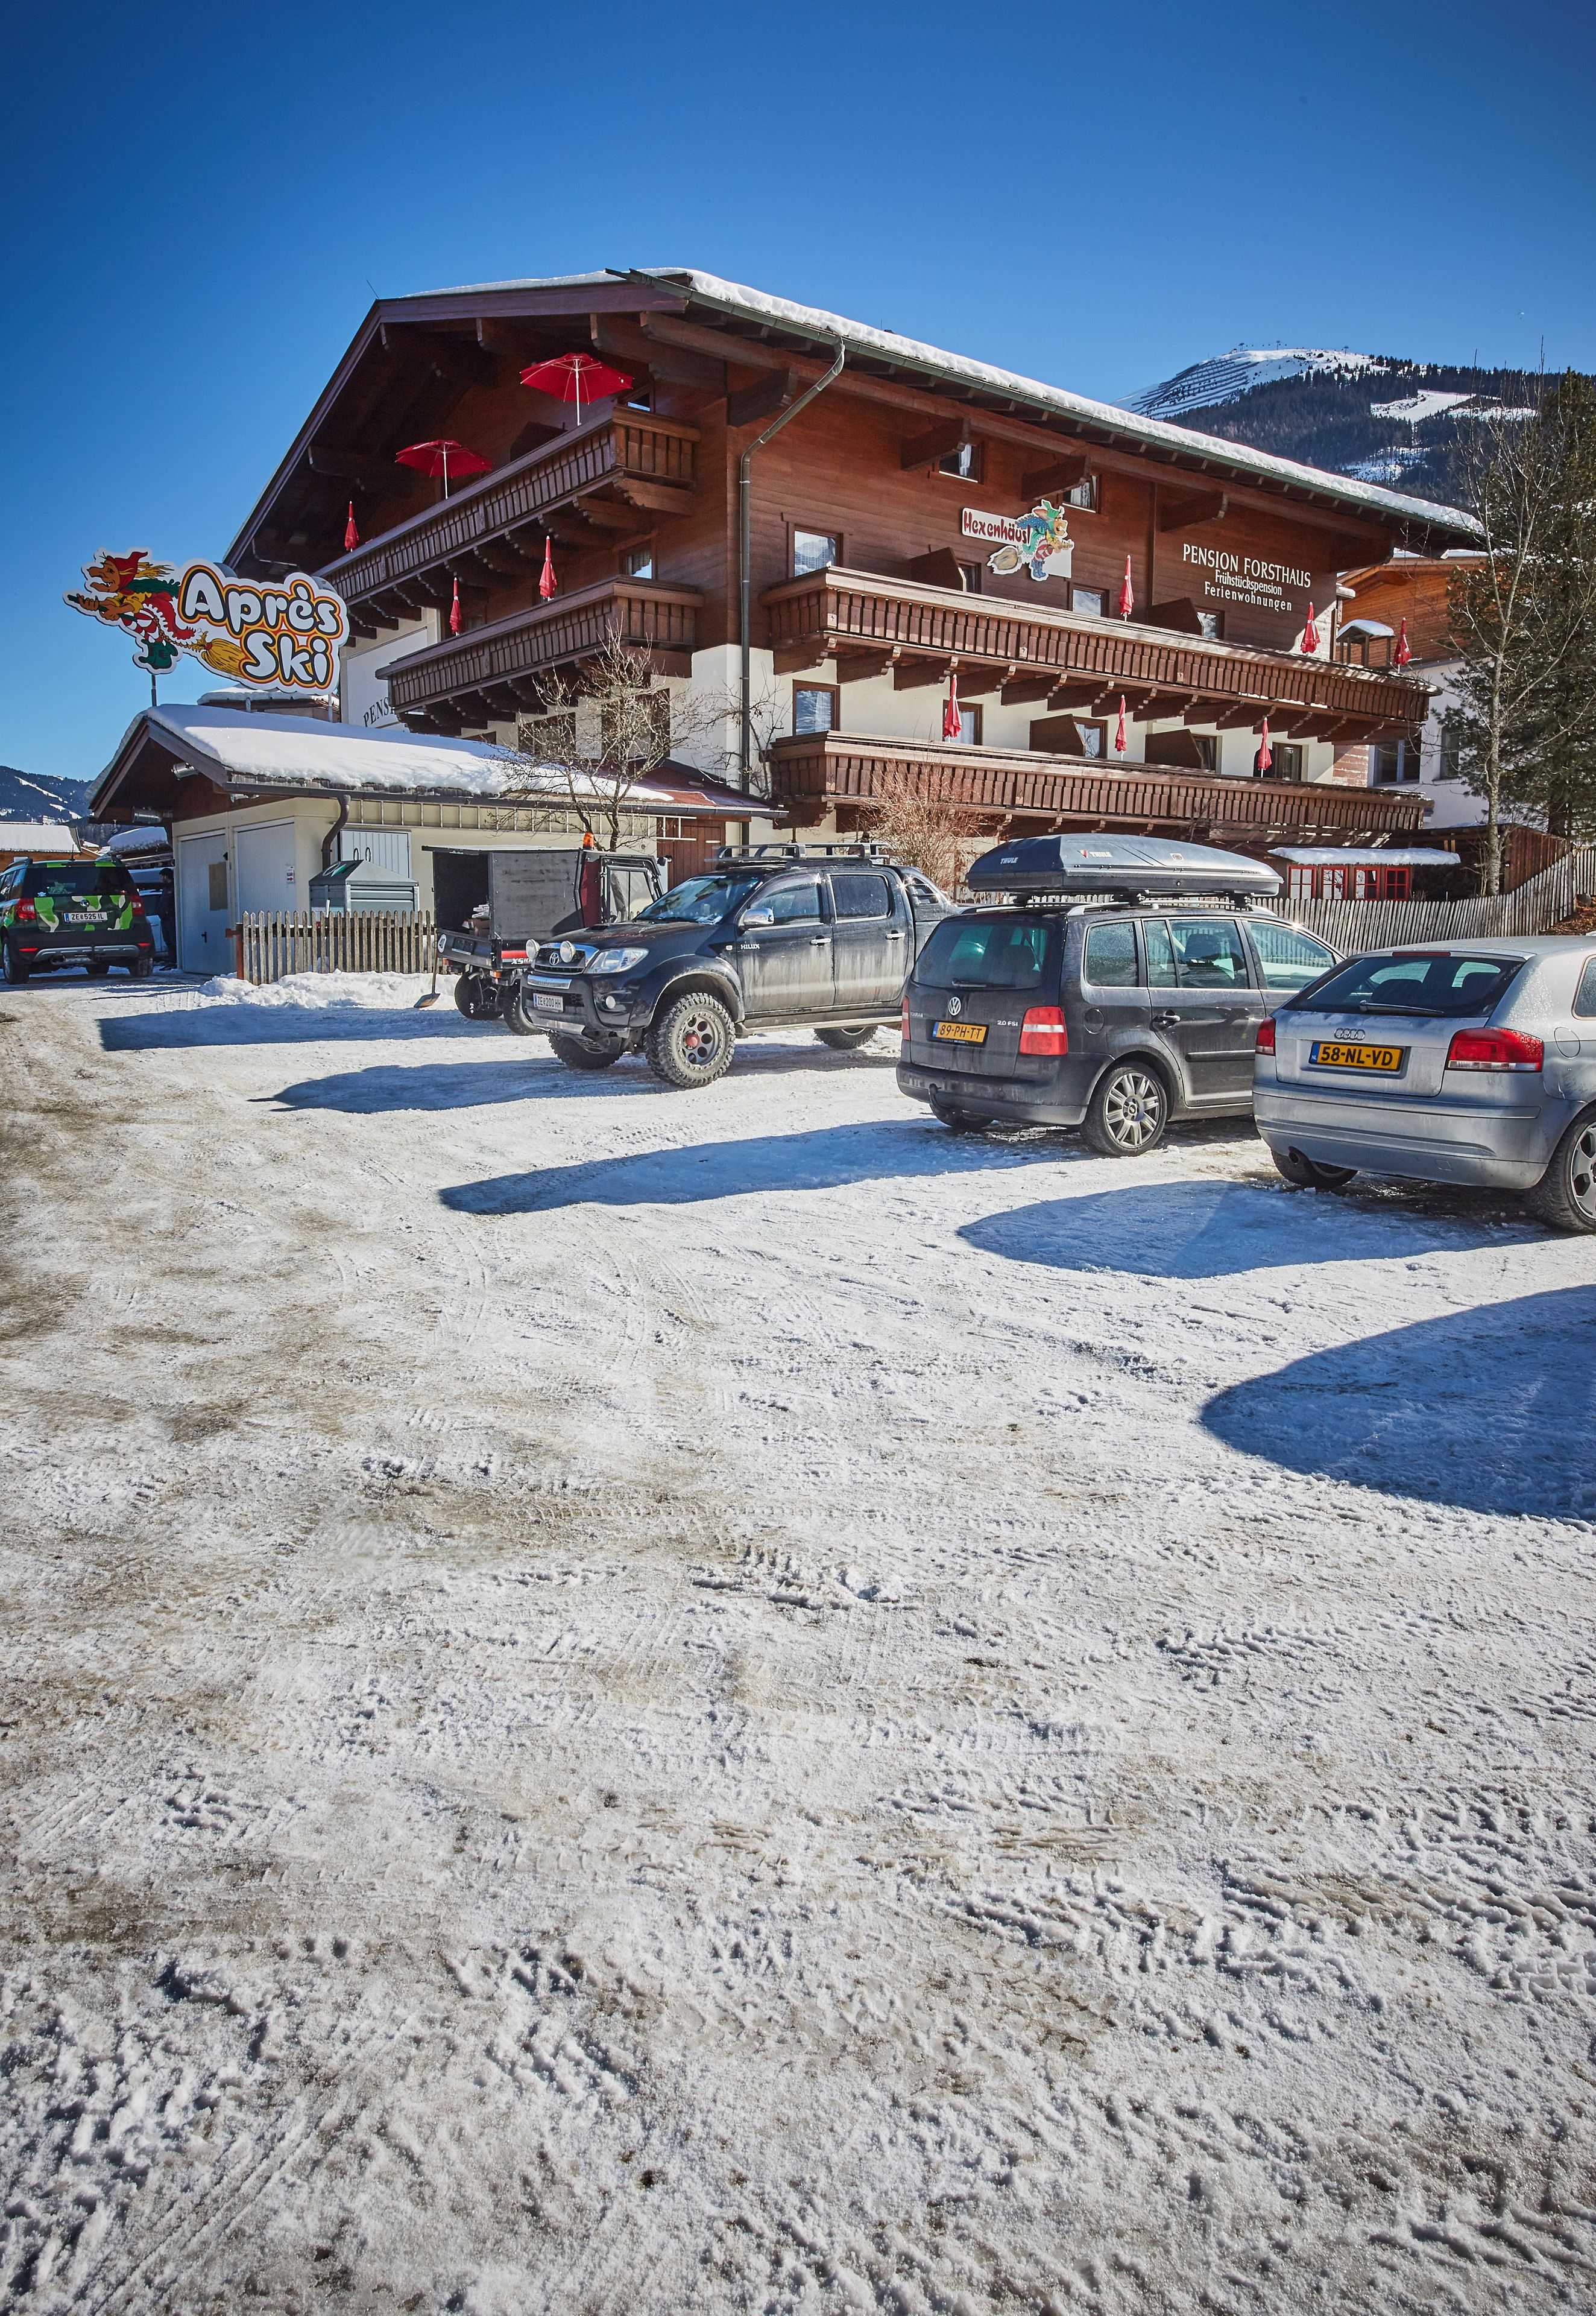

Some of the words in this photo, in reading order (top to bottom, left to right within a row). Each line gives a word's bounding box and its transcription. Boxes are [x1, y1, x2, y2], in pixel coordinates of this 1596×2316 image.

[963, 510, 1031, 545] Hexenhäusl
[1182, 543, 1239, 573] PENSION
[1244, 557, 1311, 589] FORSTHAUS
[1204, 581, 1292, 612] Ferienwohnungen
[1215, 569, 1282, 596] Frühstückspension
[181, 568, 341, 636] Après
[242, 627, 333, 685] Ski
[438, 938, 446, 949] 40
[537, 996, 543, 1005] ZE
[546, 997, 555, 1007] 200
[555, 998, 561, 1008] HH
[939, 1024, 983, 1040] 89-PH-TT
[1320, 1046, 1393, 1066] 58-NL-VD
